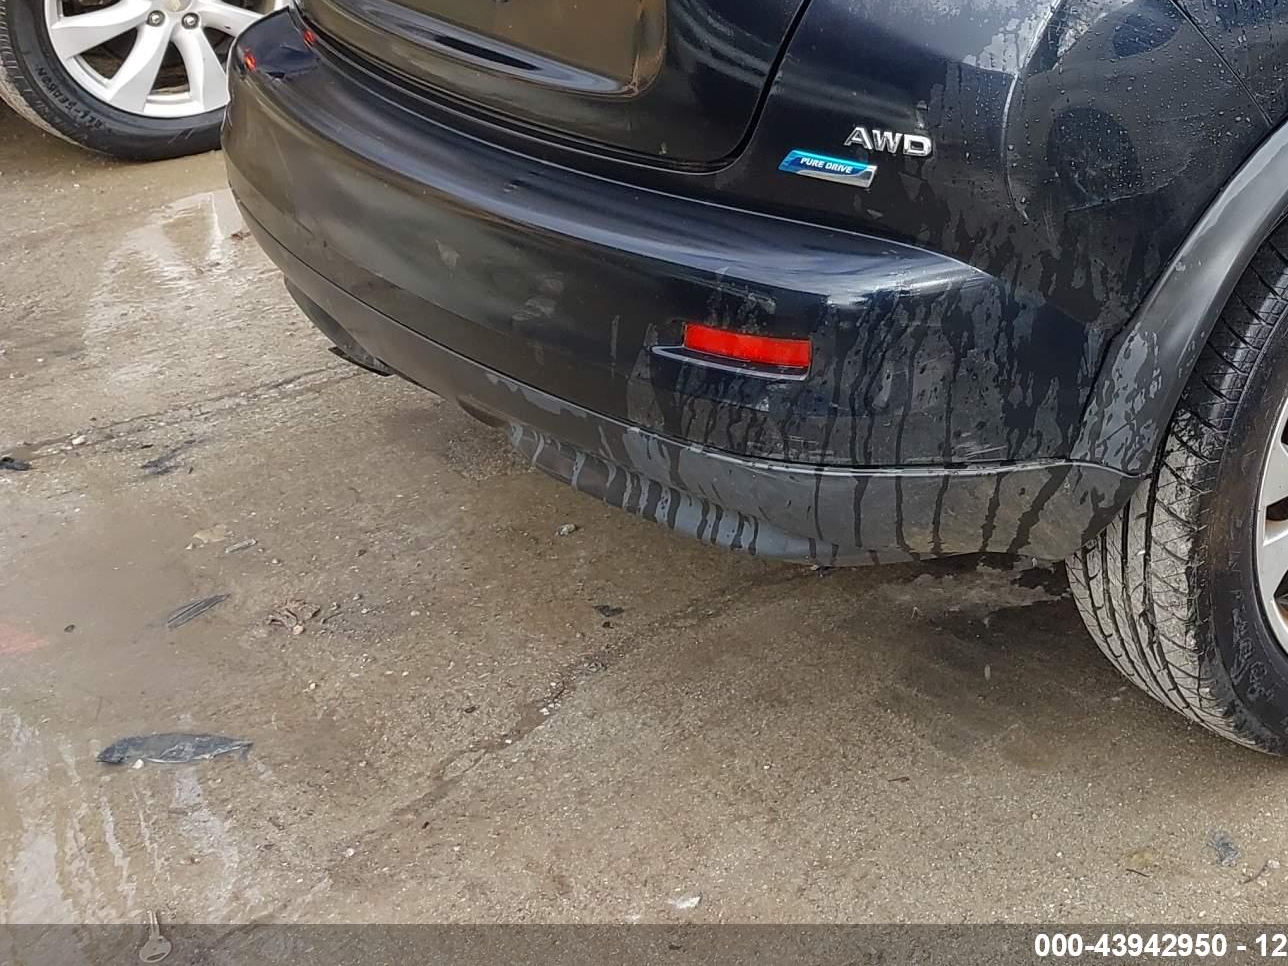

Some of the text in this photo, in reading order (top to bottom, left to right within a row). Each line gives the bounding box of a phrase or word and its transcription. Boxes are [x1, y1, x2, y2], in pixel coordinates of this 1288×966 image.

[843, 126, 933, 157] AWD
[800, 156, 854, 174] PURE DRIVE
